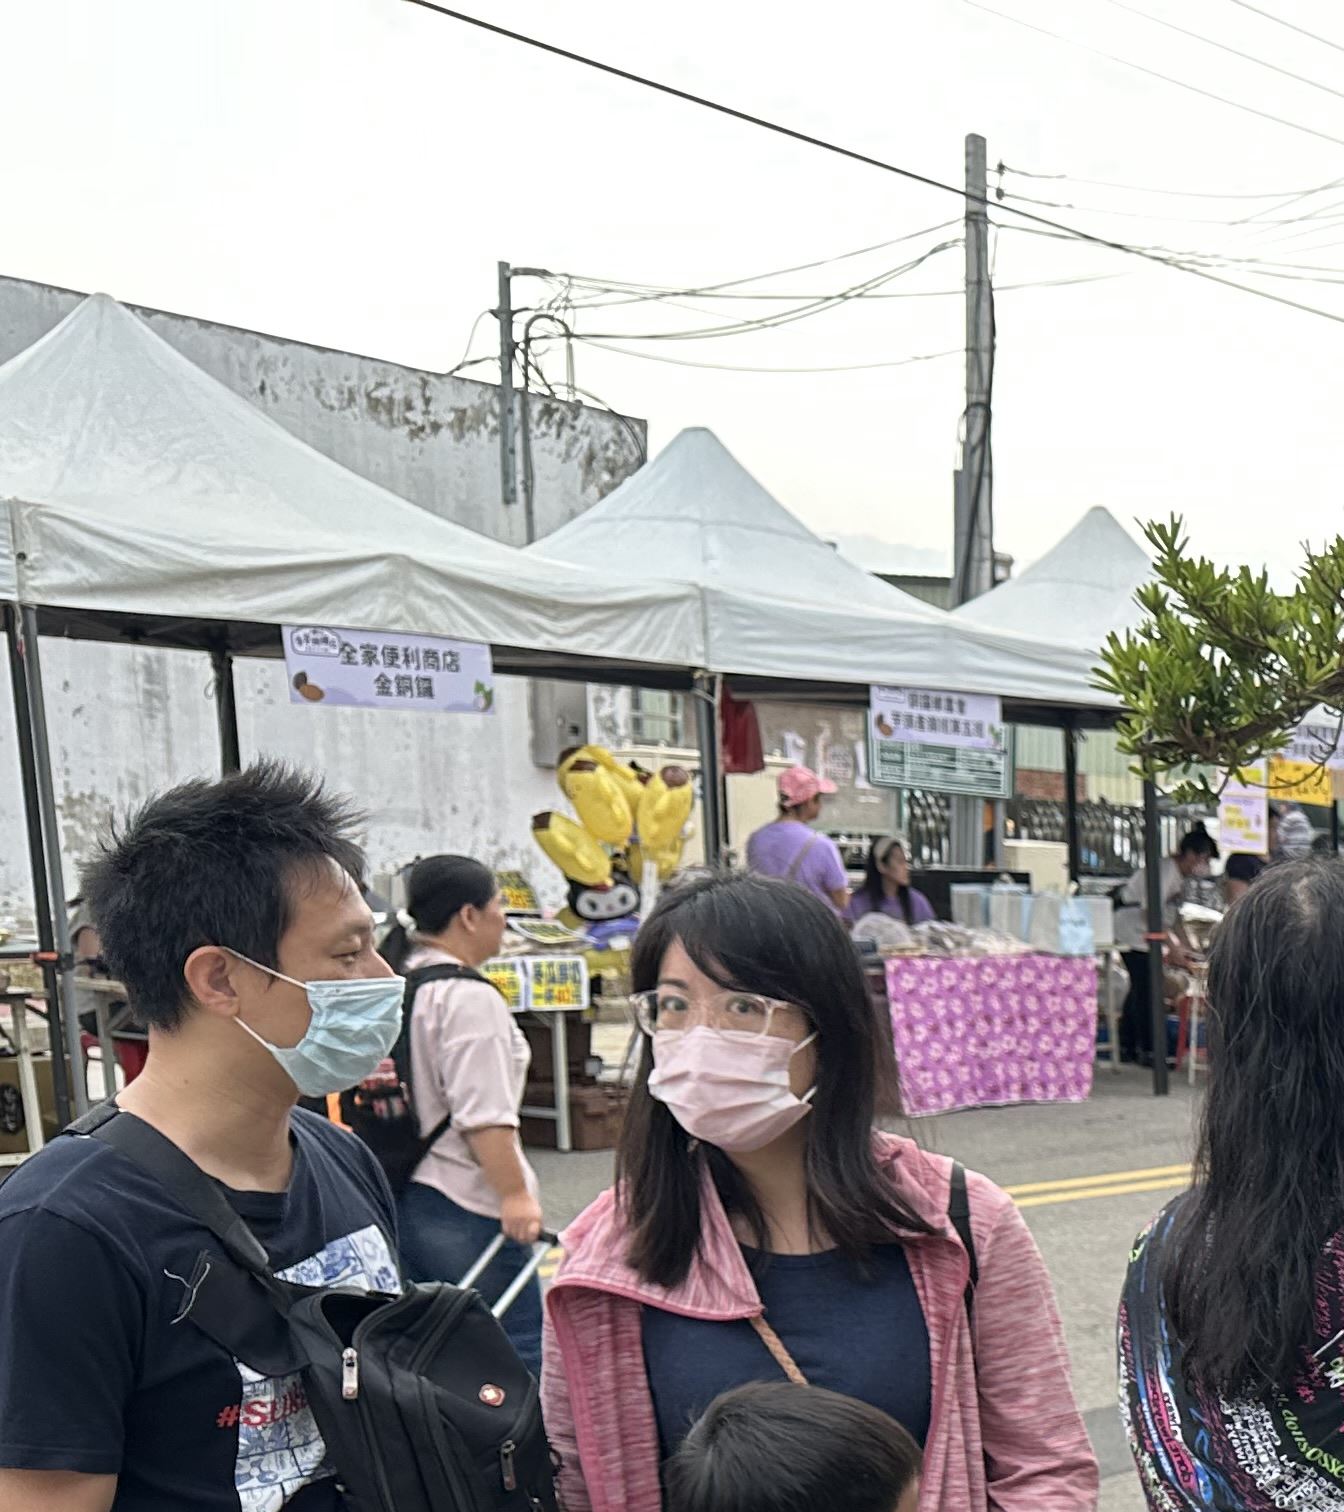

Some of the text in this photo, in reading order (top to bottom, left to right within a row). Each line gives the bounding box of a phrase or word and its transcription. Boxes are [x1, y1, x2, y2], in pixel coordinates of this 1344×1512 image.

[340, 640, 462, 673] 全家便利商店
